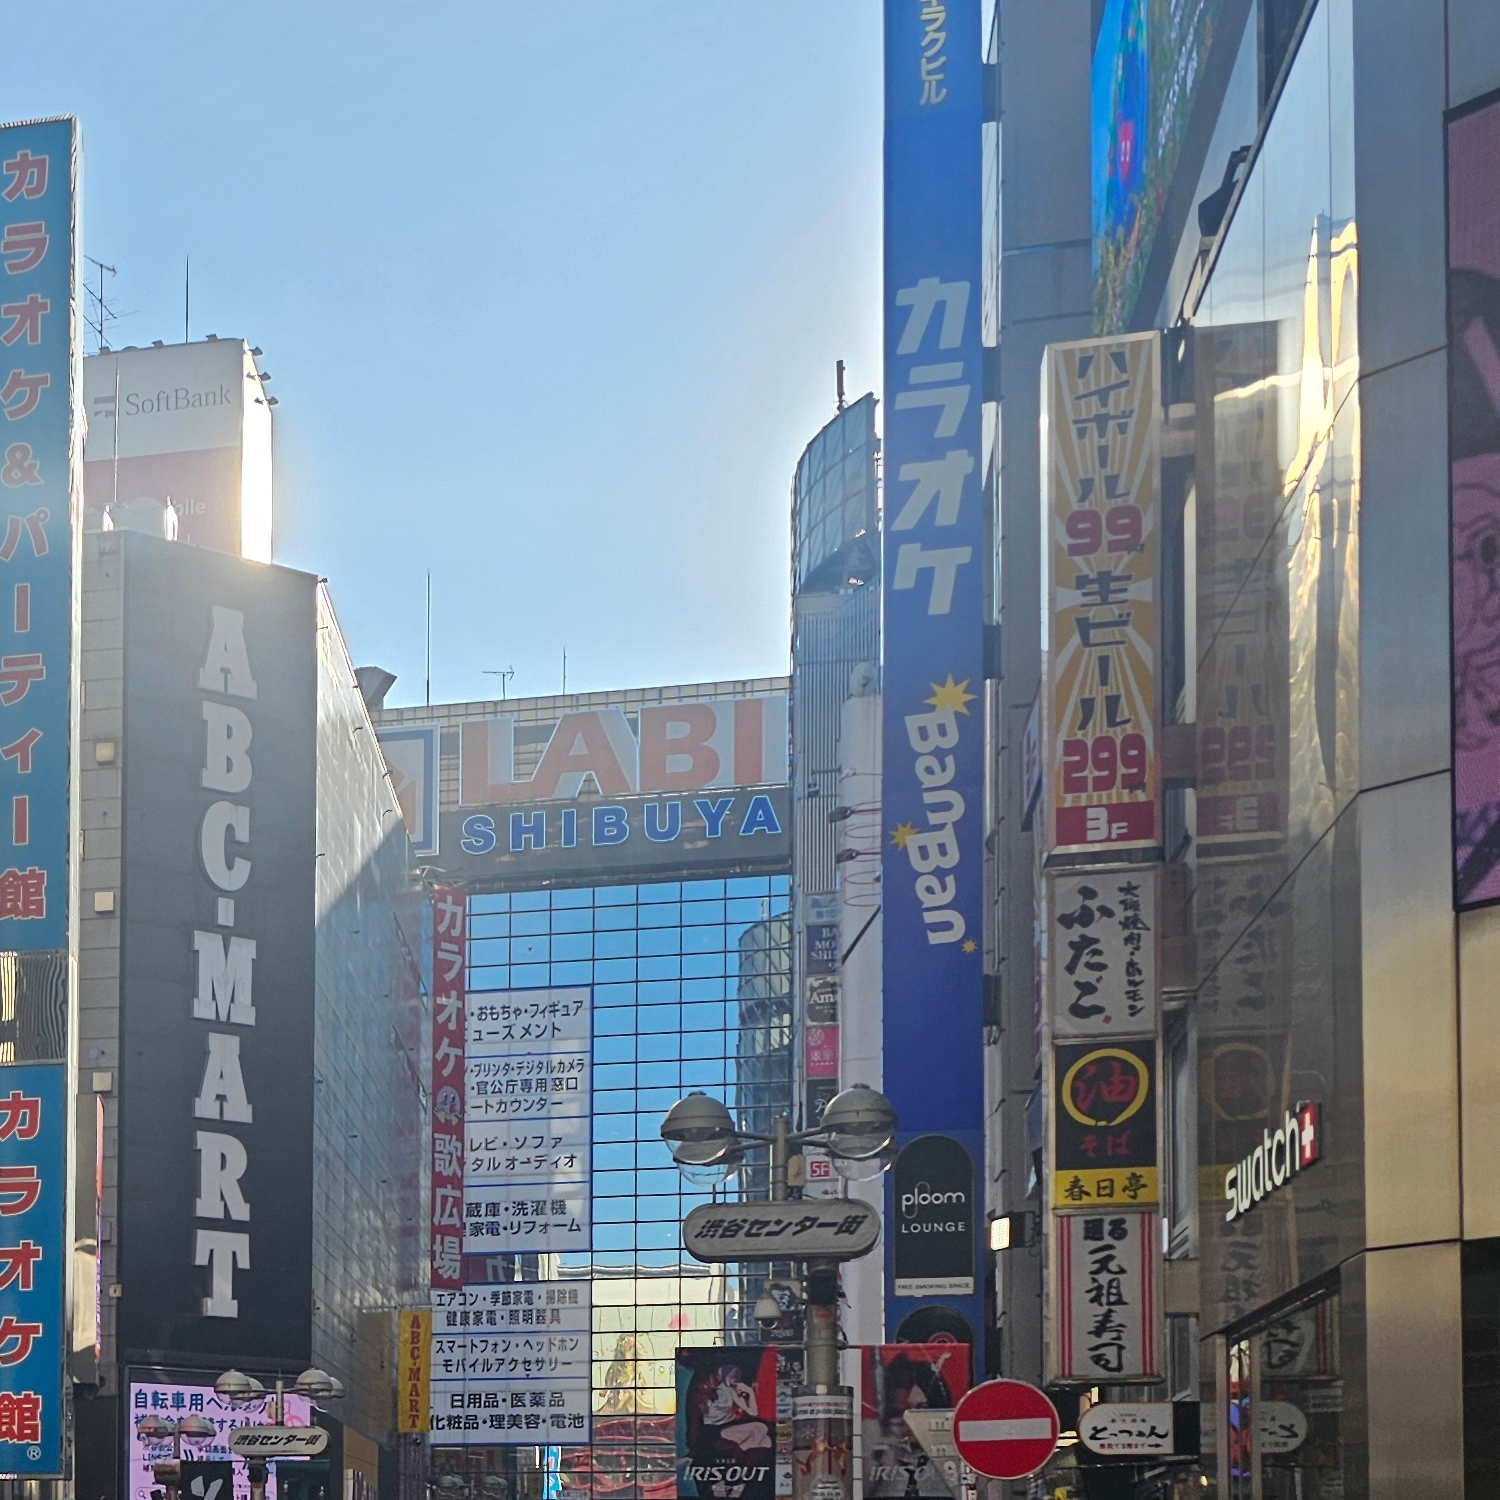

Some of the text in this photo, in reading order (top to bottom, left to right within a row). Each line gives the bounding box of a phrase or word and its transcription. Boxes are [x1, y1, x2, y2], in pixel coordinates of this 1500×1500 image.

[919, 0, 947, 106] ラクビル
[126, 384, 232, 417] SoftBank
[1072, 350, 1134, 503] ハイボール
[890, 277, 975, 616] カラオケ
[1074, 570, 1133, 732] 生ビール
[460, 695, 789, 805] LABI
[461, 795, 781, 855] SHIBUYA
[904, 711, 966, 946] BanBan
[1086, 807, 1129, 842] 3F
[191, 605, 258, 1318] ABC-MART
[1057, 885, 1116, 1019] ふたご
[466, 1000, 583, 1022] ・おもちゃ・フィギュア
[466, 1022, 562, 1043] ューズメント
[466, 1058, 585, 1078] ・プリンタ・デジタルカメラ
[466, 1076, 578, 1096] ・官公庁専用窓口
[1072, 1061, 1139, 1115] 油
[466, 1096, 564, 1115] ートカウンター
[1080, 1130, 1130, 1157] そば
[465, 1153, 577, 1172] タルオーディオ
[1225, 1108, 1300, 1222] swatch
[902, 1182, 965, 1219] ploom
[1064, 1173, 1149, 1201] 春日亭
[694, 1214, 868, 1239] 渋谷センター街
[902, 1222, 966, 1233] LOUNGE
[1083, 1243, 1130, 1374] 元祖寿司
[435, 1337, 580, 1355] スマートフォン・ヘッドホン
[442, 1356, 573, 1374] モバイルアクセサリー
[450, 1391, 566, 1410] 日用品・医薬品
[430, 1412, 585, 1431] 化粧品・理美容・電池
[234, 1434, 322, 1446] 渋谷センター街
[683, 1465, 770, 1482] IRIS OUT
